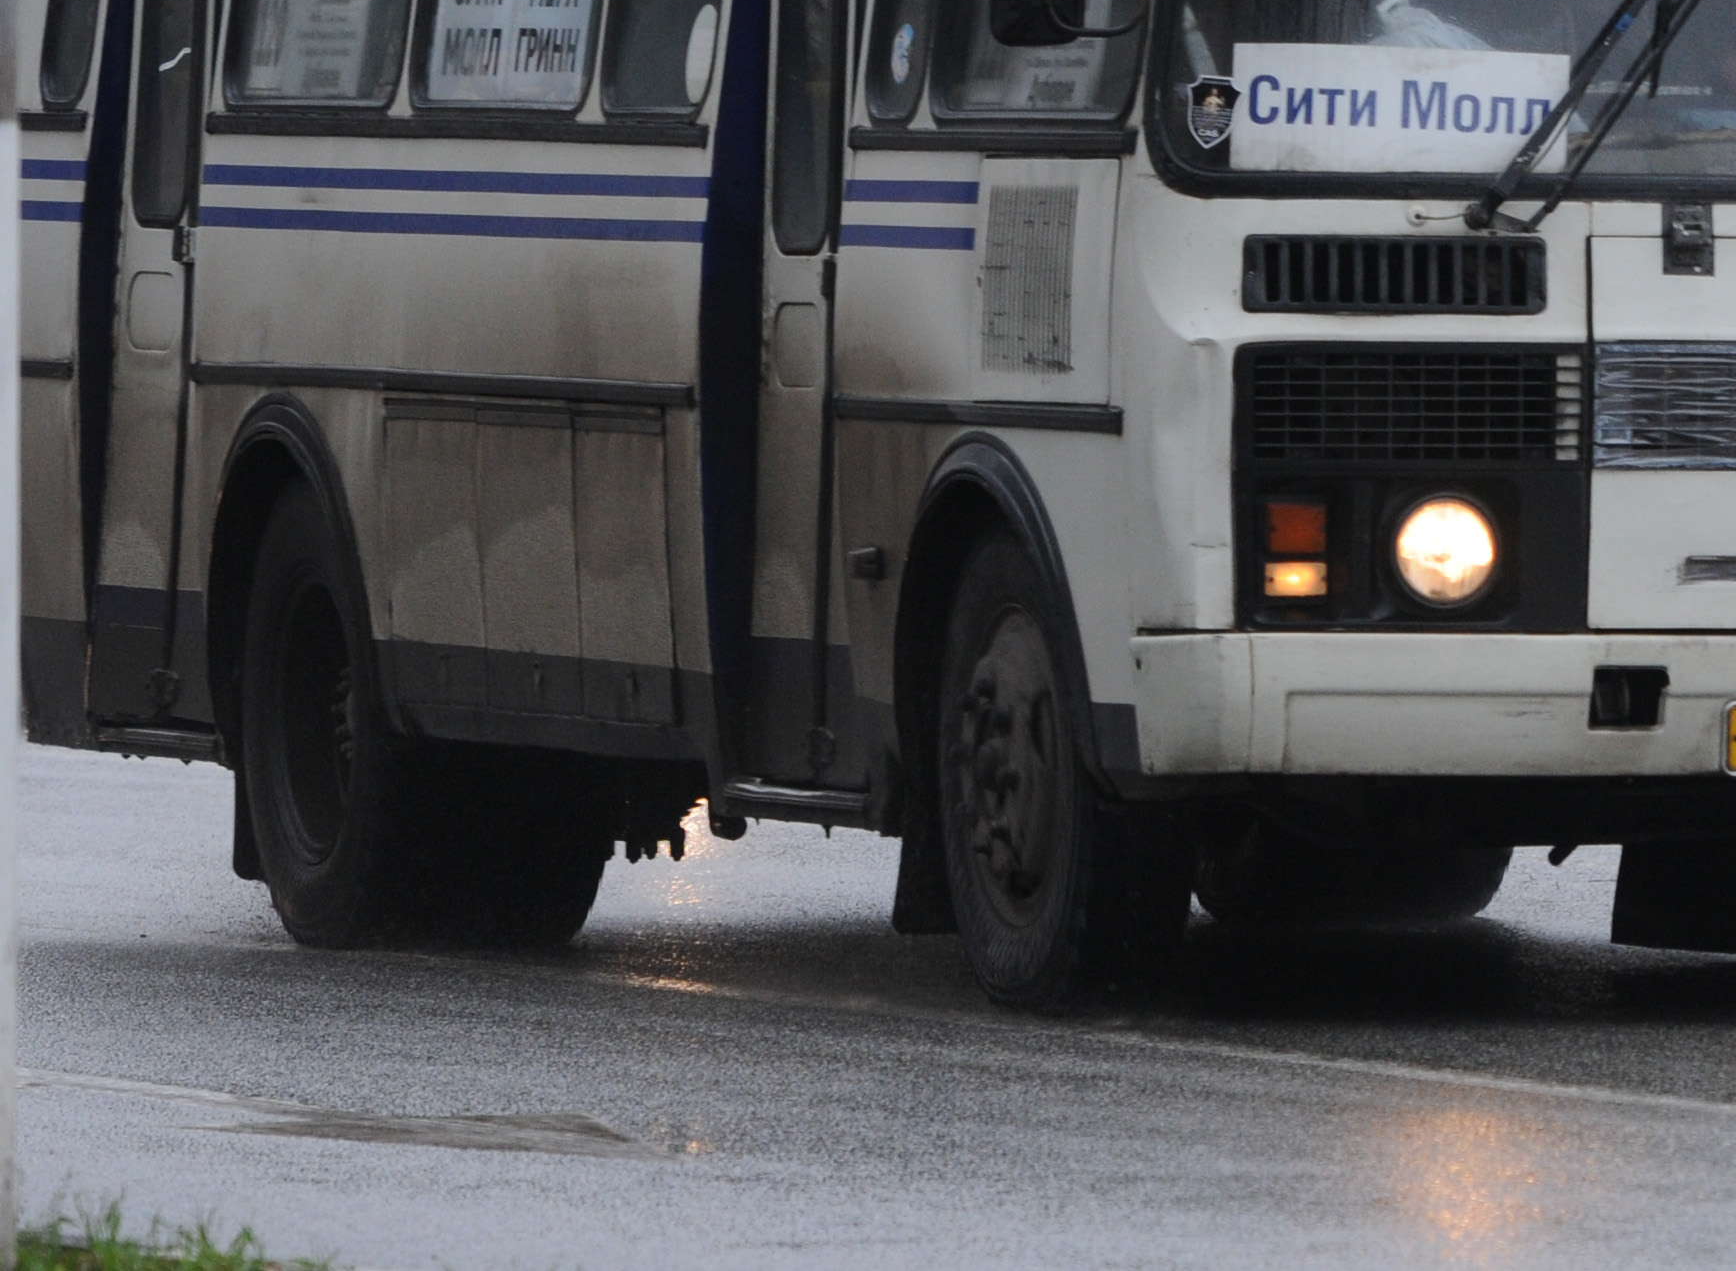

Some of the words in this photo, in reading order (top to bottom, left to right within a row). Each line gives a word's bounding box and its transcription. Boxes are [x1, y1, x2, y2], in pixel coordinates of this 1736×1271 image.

[442, 28, 502, 76] МОЛЛ
[514, 27, 580, 73] ГРИНН
[1248, 74, 1378, 128] Сити
[1401, 80, 1553, 136] Молл
